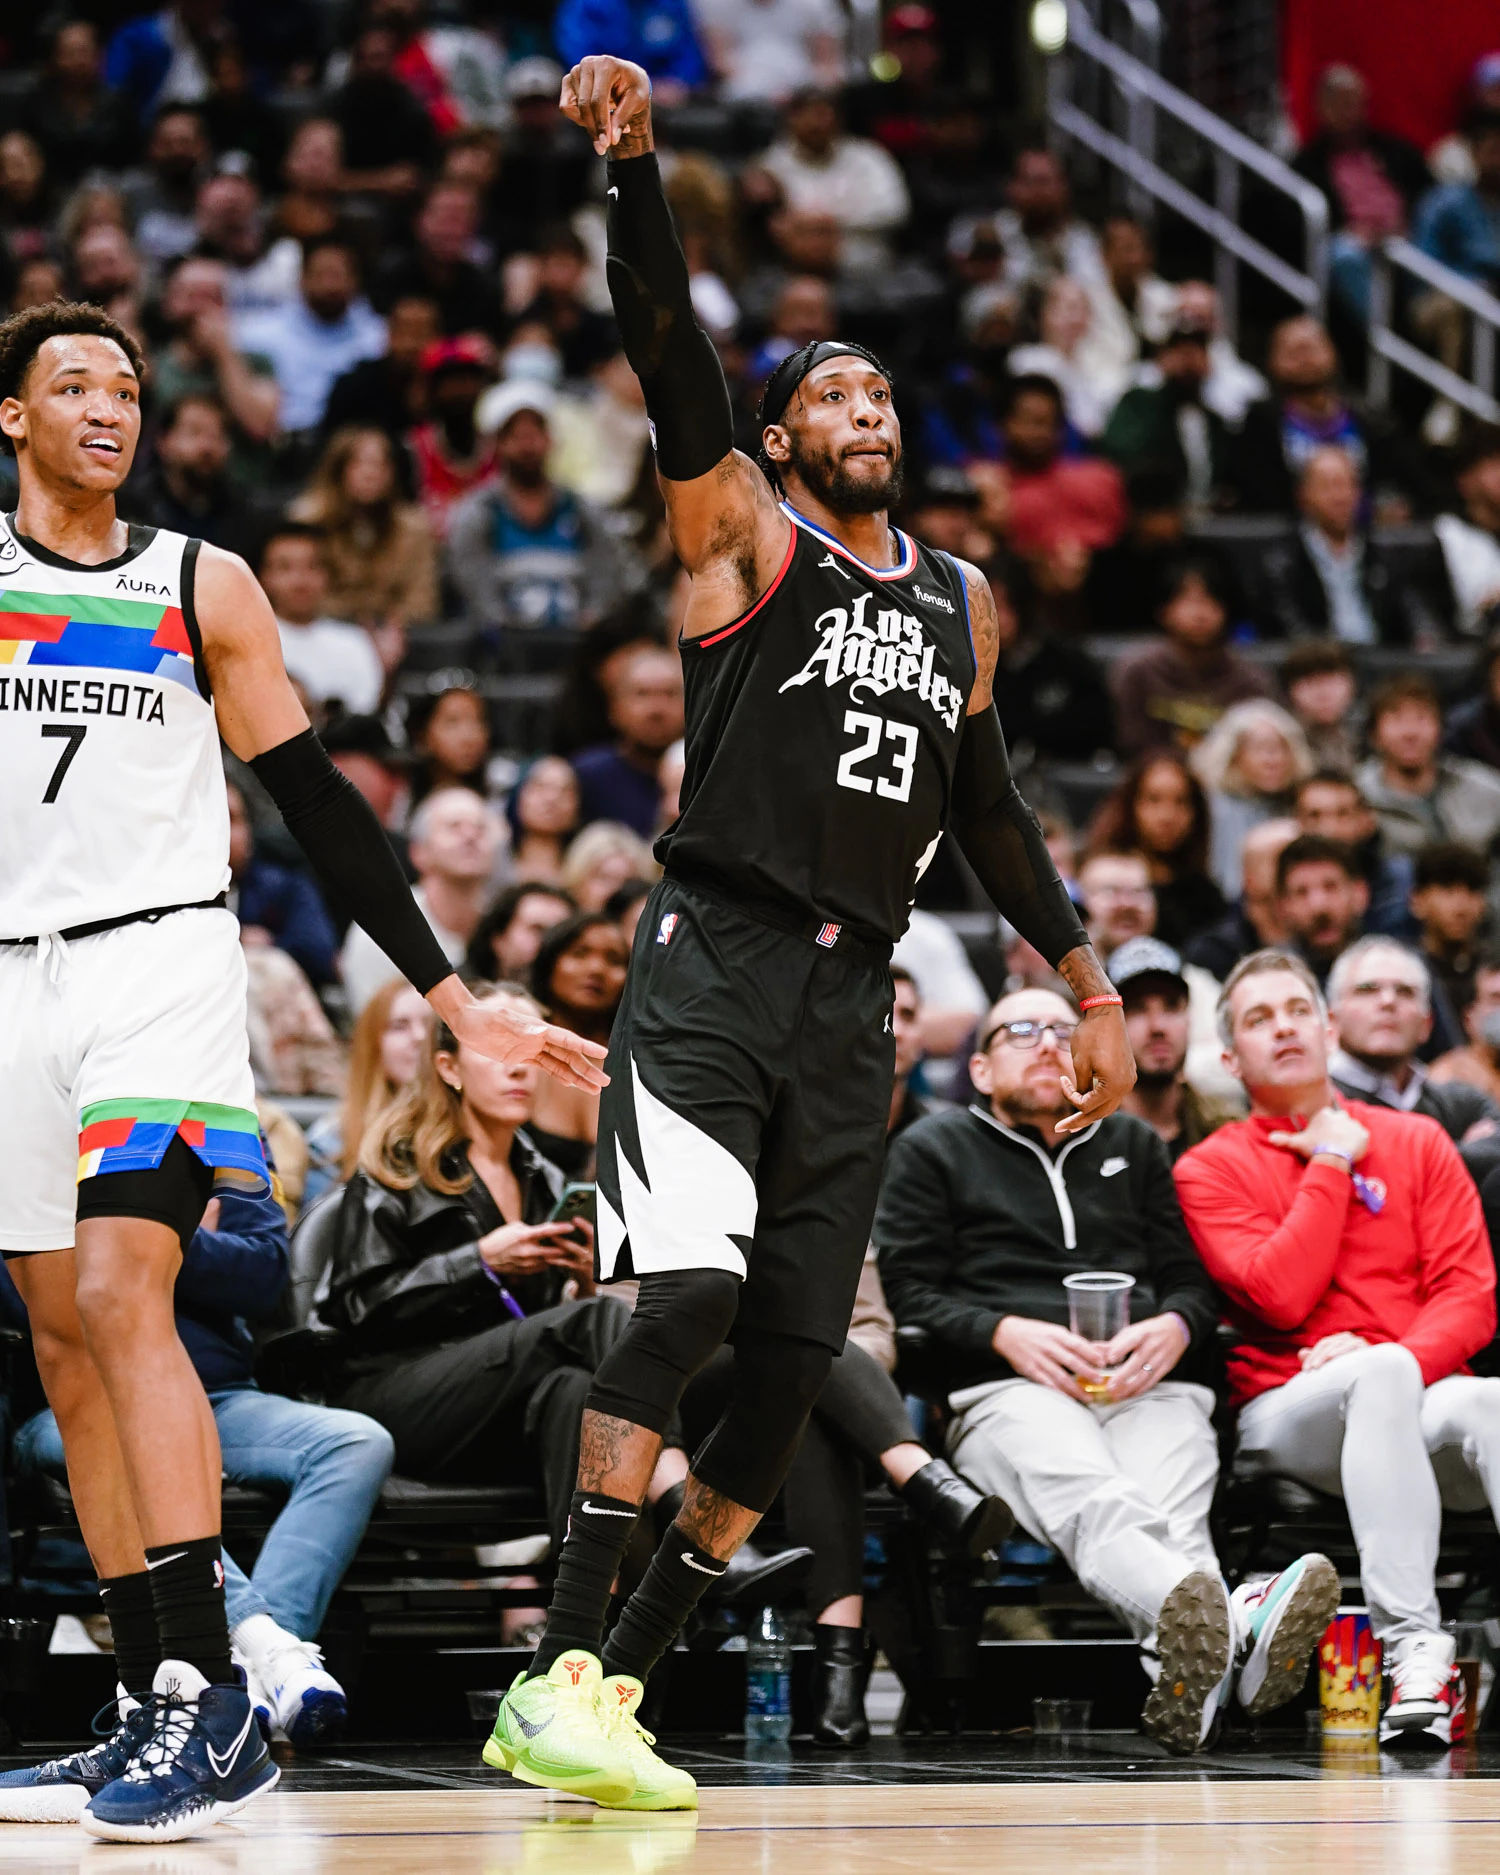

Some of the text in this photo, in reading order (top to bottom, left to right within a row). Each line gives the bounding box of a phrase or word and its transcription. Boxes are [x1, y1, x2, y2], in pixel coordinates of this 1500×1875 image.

[845, 592, 923, 656] Los
[912, 585, 955, 614] honey
[778, 608, 963, 733] Angeles
[41, 724, 87, 803] 7
[837, 709, 919, 803] 23
